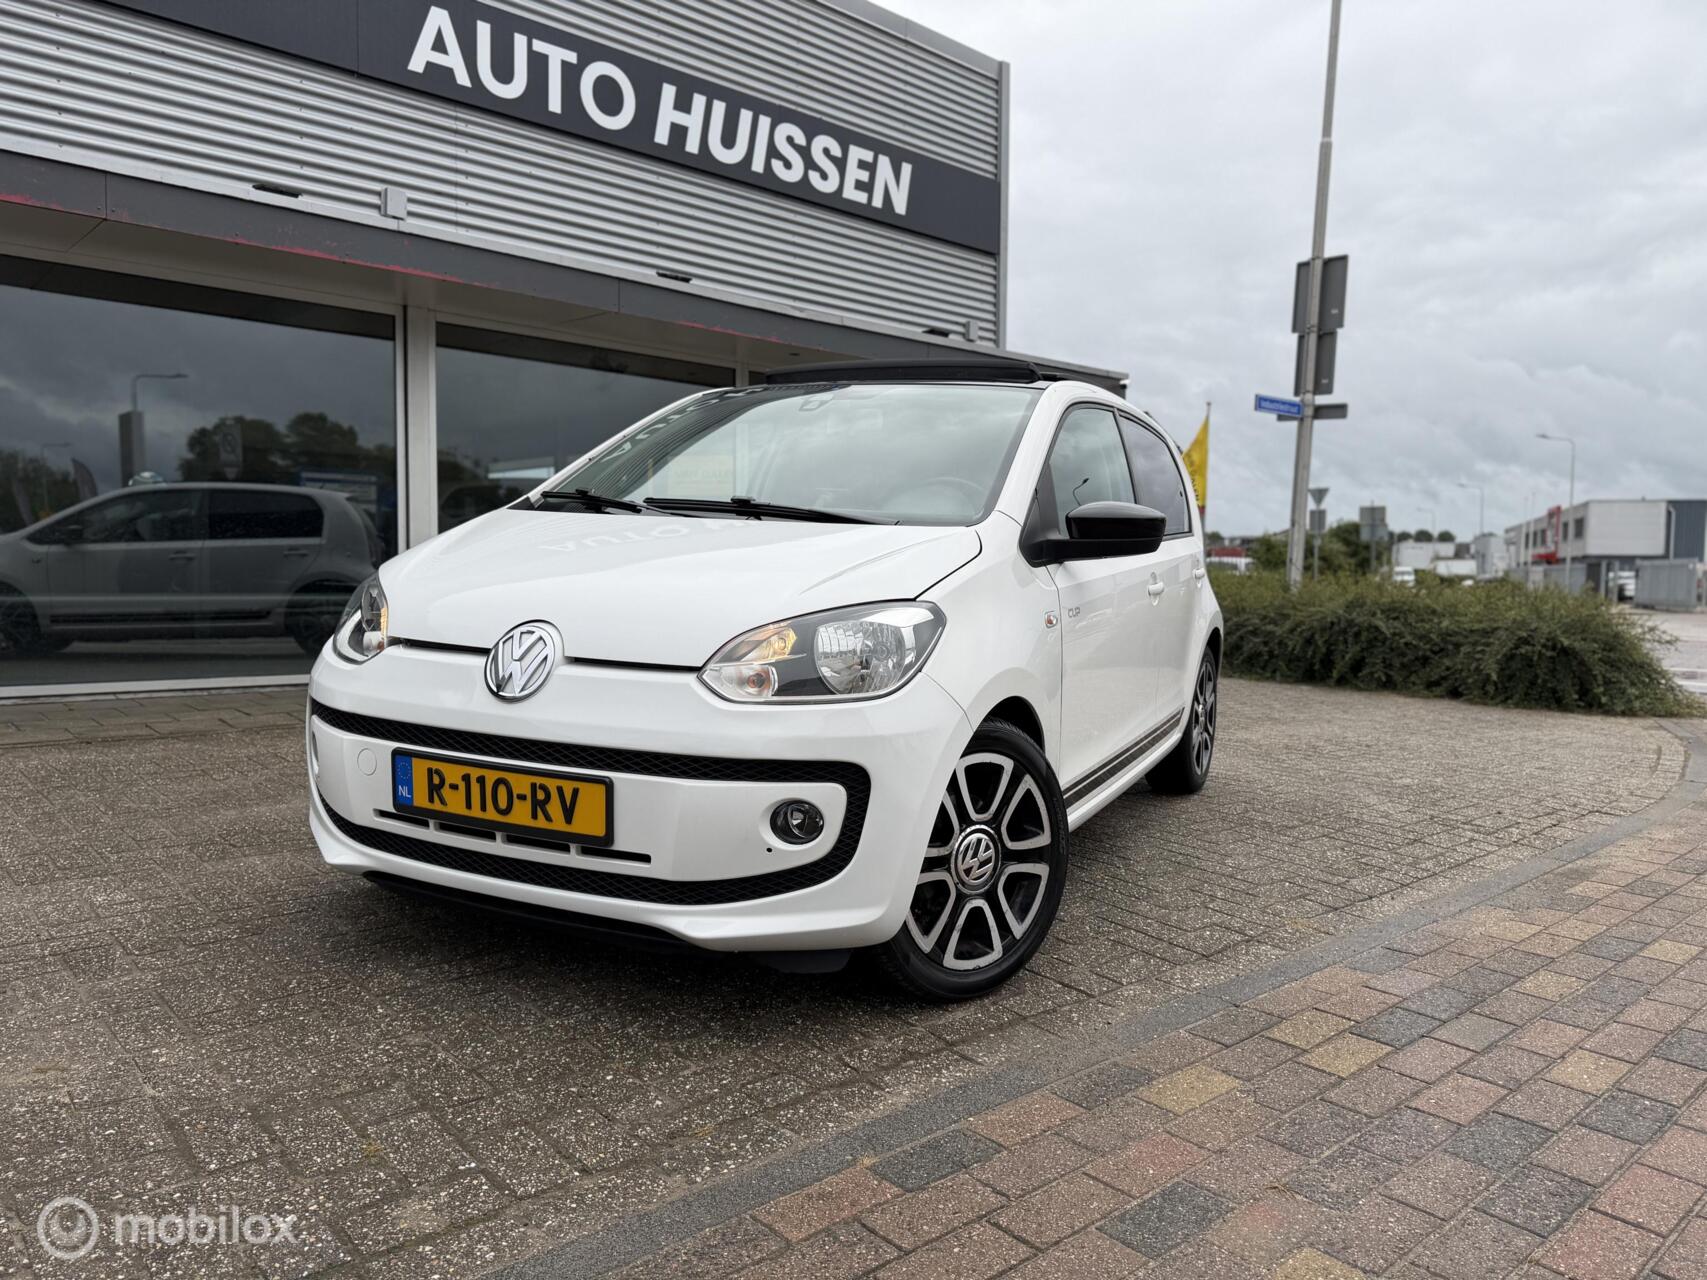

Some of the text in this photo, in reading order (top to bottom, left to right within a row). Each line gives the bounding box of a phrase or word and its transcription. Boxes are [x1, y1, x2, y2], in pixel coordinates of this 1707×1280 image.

[407, 5, 913, 216] AUTO HUISSEN
[485, 623, 556, 699] VW
[398, 784, 412, 799] NL
[426, 766, 580, 826] R-110-RV
[957, 832, 996, 886] VW
